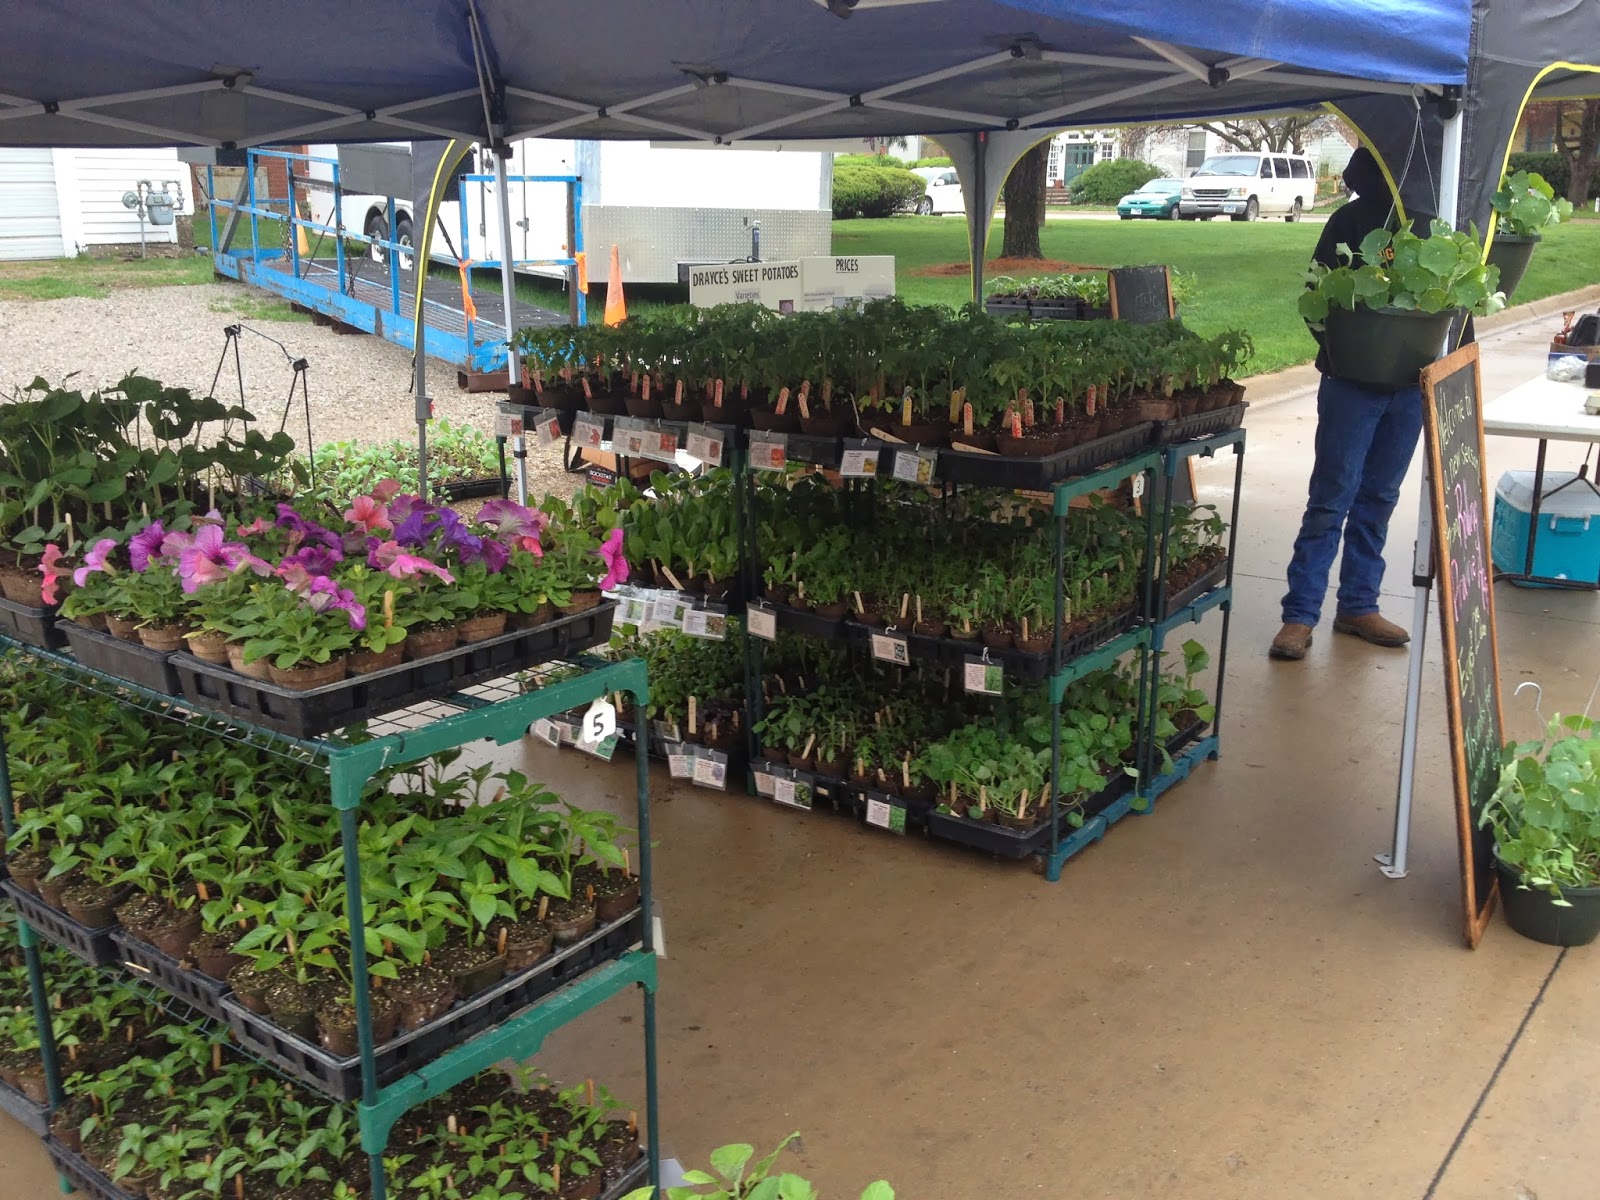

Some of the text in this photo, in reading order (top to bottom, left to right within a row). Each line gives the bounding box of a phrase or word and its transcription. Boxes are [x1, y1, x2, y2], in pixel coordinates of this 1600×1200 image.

[693, 265, 798, 286] DRAYCE'S SWEET POTATOES
[835, 258, 859, 272] PRICES
[1434, 384, 1473, 456] Welcome to
[1135, 480, 1141, 493] 3
[593, 712, 604, 736] 5
